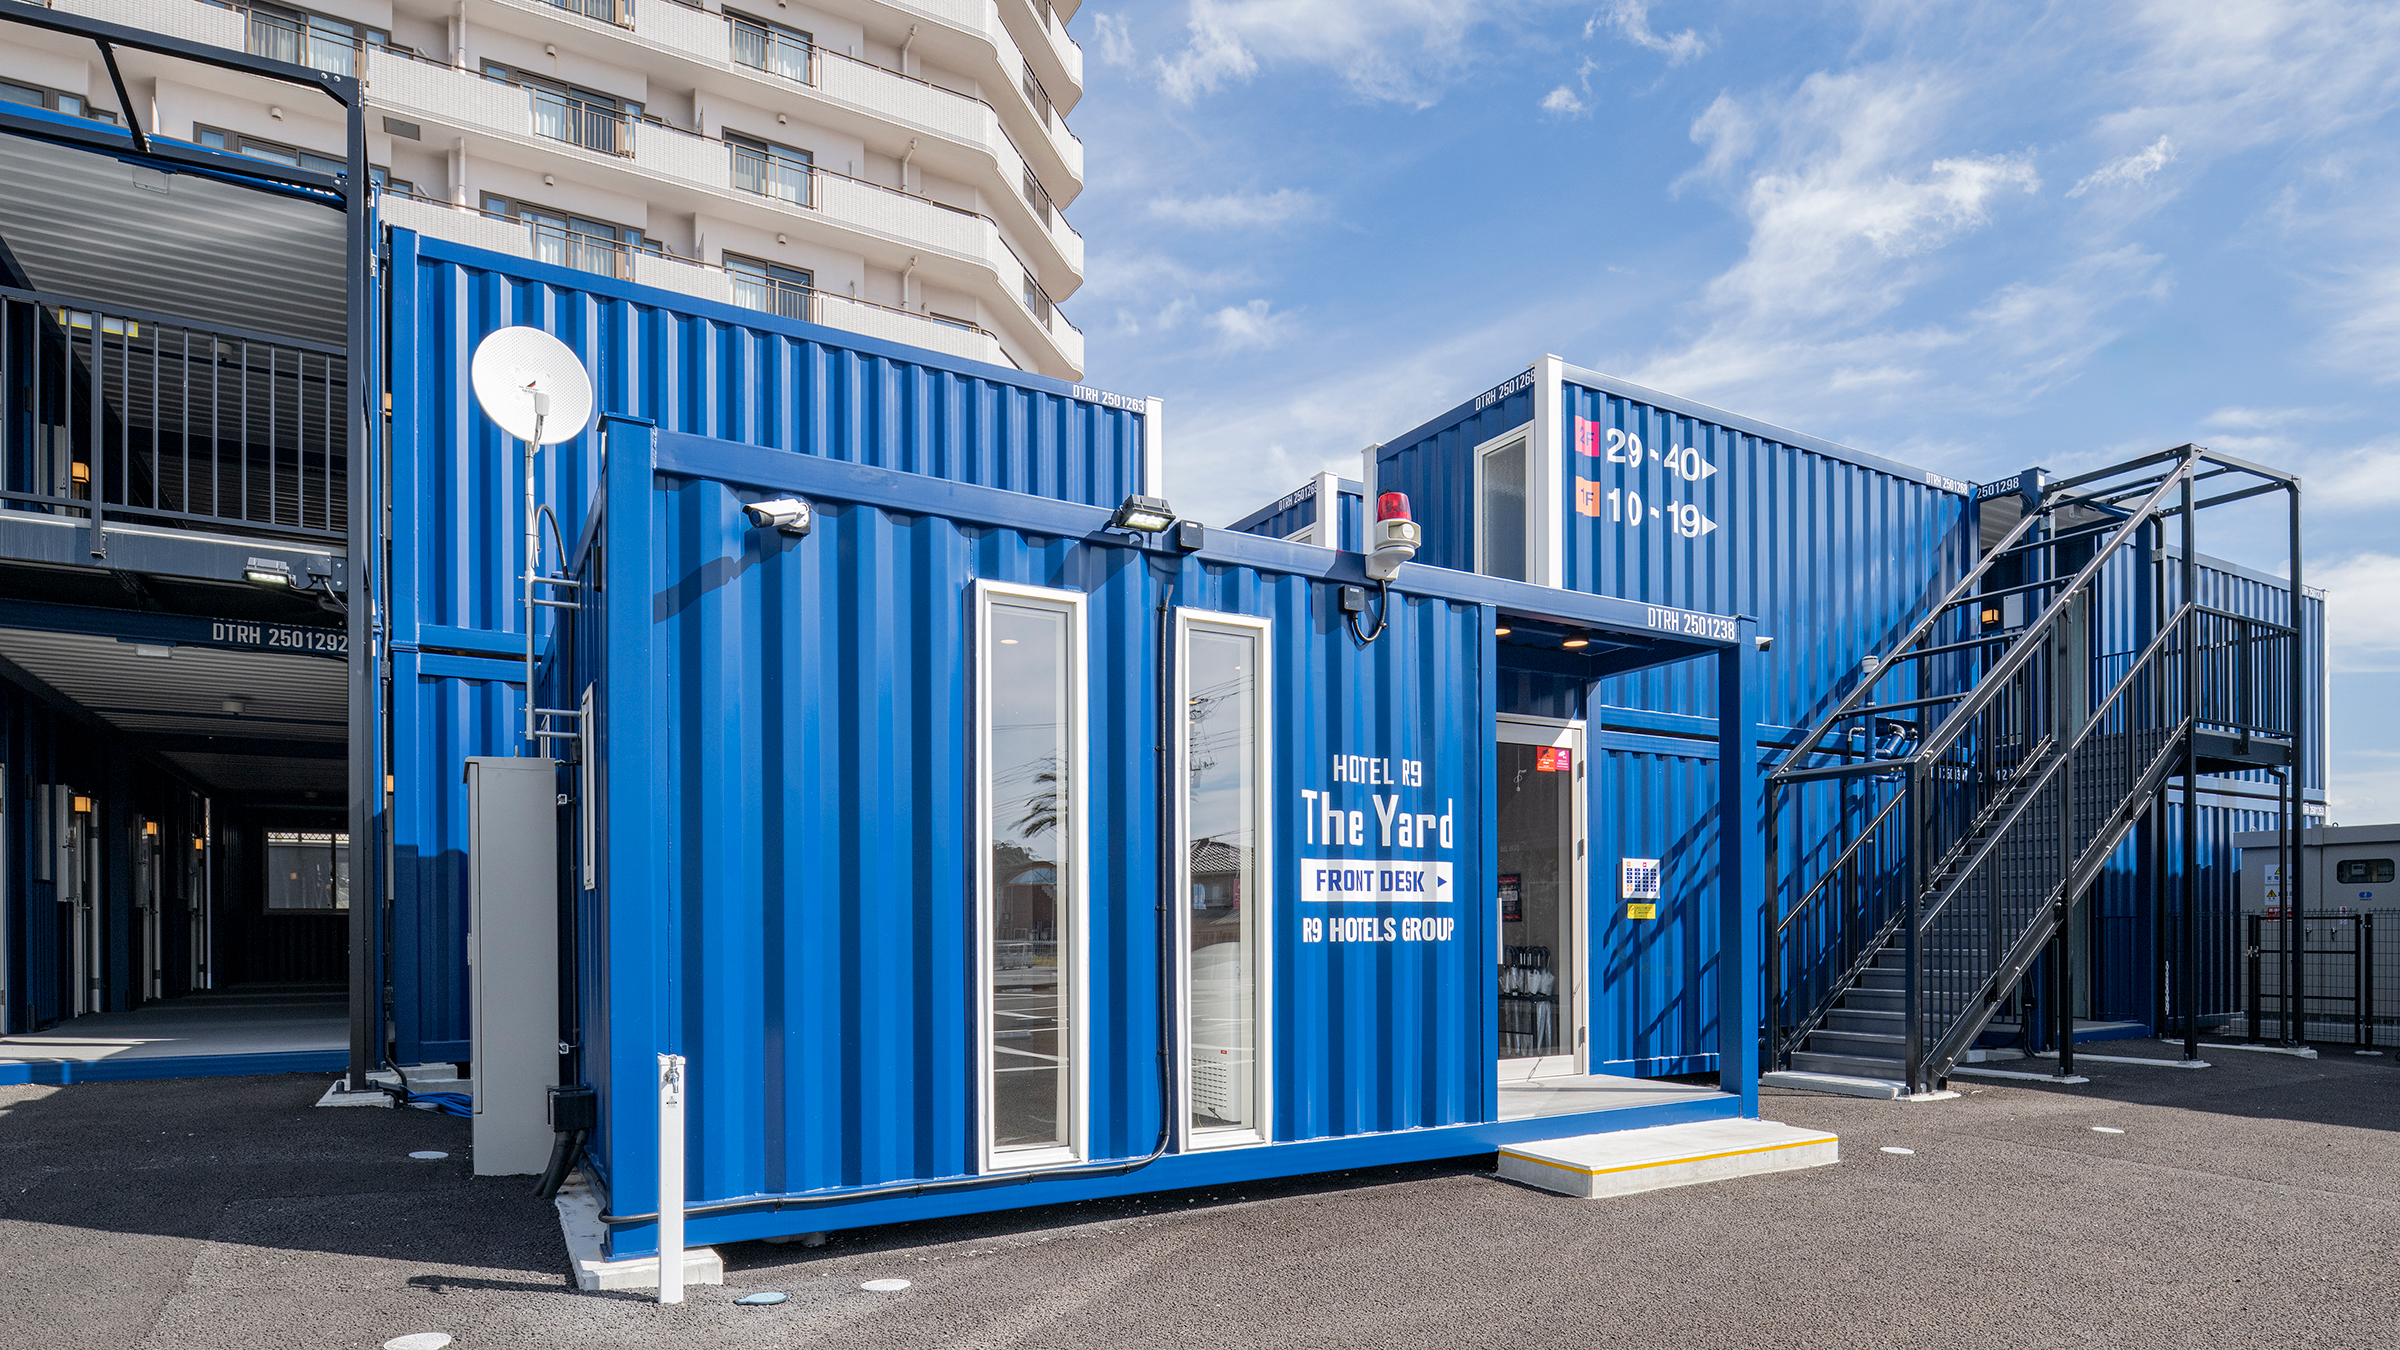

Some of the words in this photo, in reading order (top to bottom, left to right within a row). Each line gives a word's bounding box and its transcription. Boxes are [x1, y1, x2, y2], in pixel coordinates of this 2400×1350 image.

[1073, 384, 1099, 402] DTRH
[1101, 391, 1145, 412] 2501263
[1475, 389, 1496, 411] DTRH
[1579, 426, 1595, 446] 2F
[1606, 427, 1643, 468] 29
[1663, 443, 1700, 482] 40
[1925, 472, 1942, 486] DTRH
[1976, 476, 2020, 499] 2501298
[1278, 494, 1293, 512] DTRH
[1580, 487, 1594, 506] 1F
[1607, 487, 1643, 527] 10
[1666, 500, 1700, 538] 19
[212, 622, 261, 645] DTRH
[268, 628, 348, 652] 2501292
[1647, 607, 1679, 632] DTRH
[1683, 613, 1735, 640] 2501238
[1333, 754, 1395, 785] HOTEL
[1402, 758, 1422, 787] R9
[1301, 789, 1364, 846] The
[1372, 794, 1453, 849] Yard
[1316, 869, 1374, 892] FRONT
[1380, 869, 1425, 893] DESK
[1302, 917, 1323, 943] R9
[1329, 917, 1397, 943] HOTELS
[1402, 917, 1455, 942] GROUP
